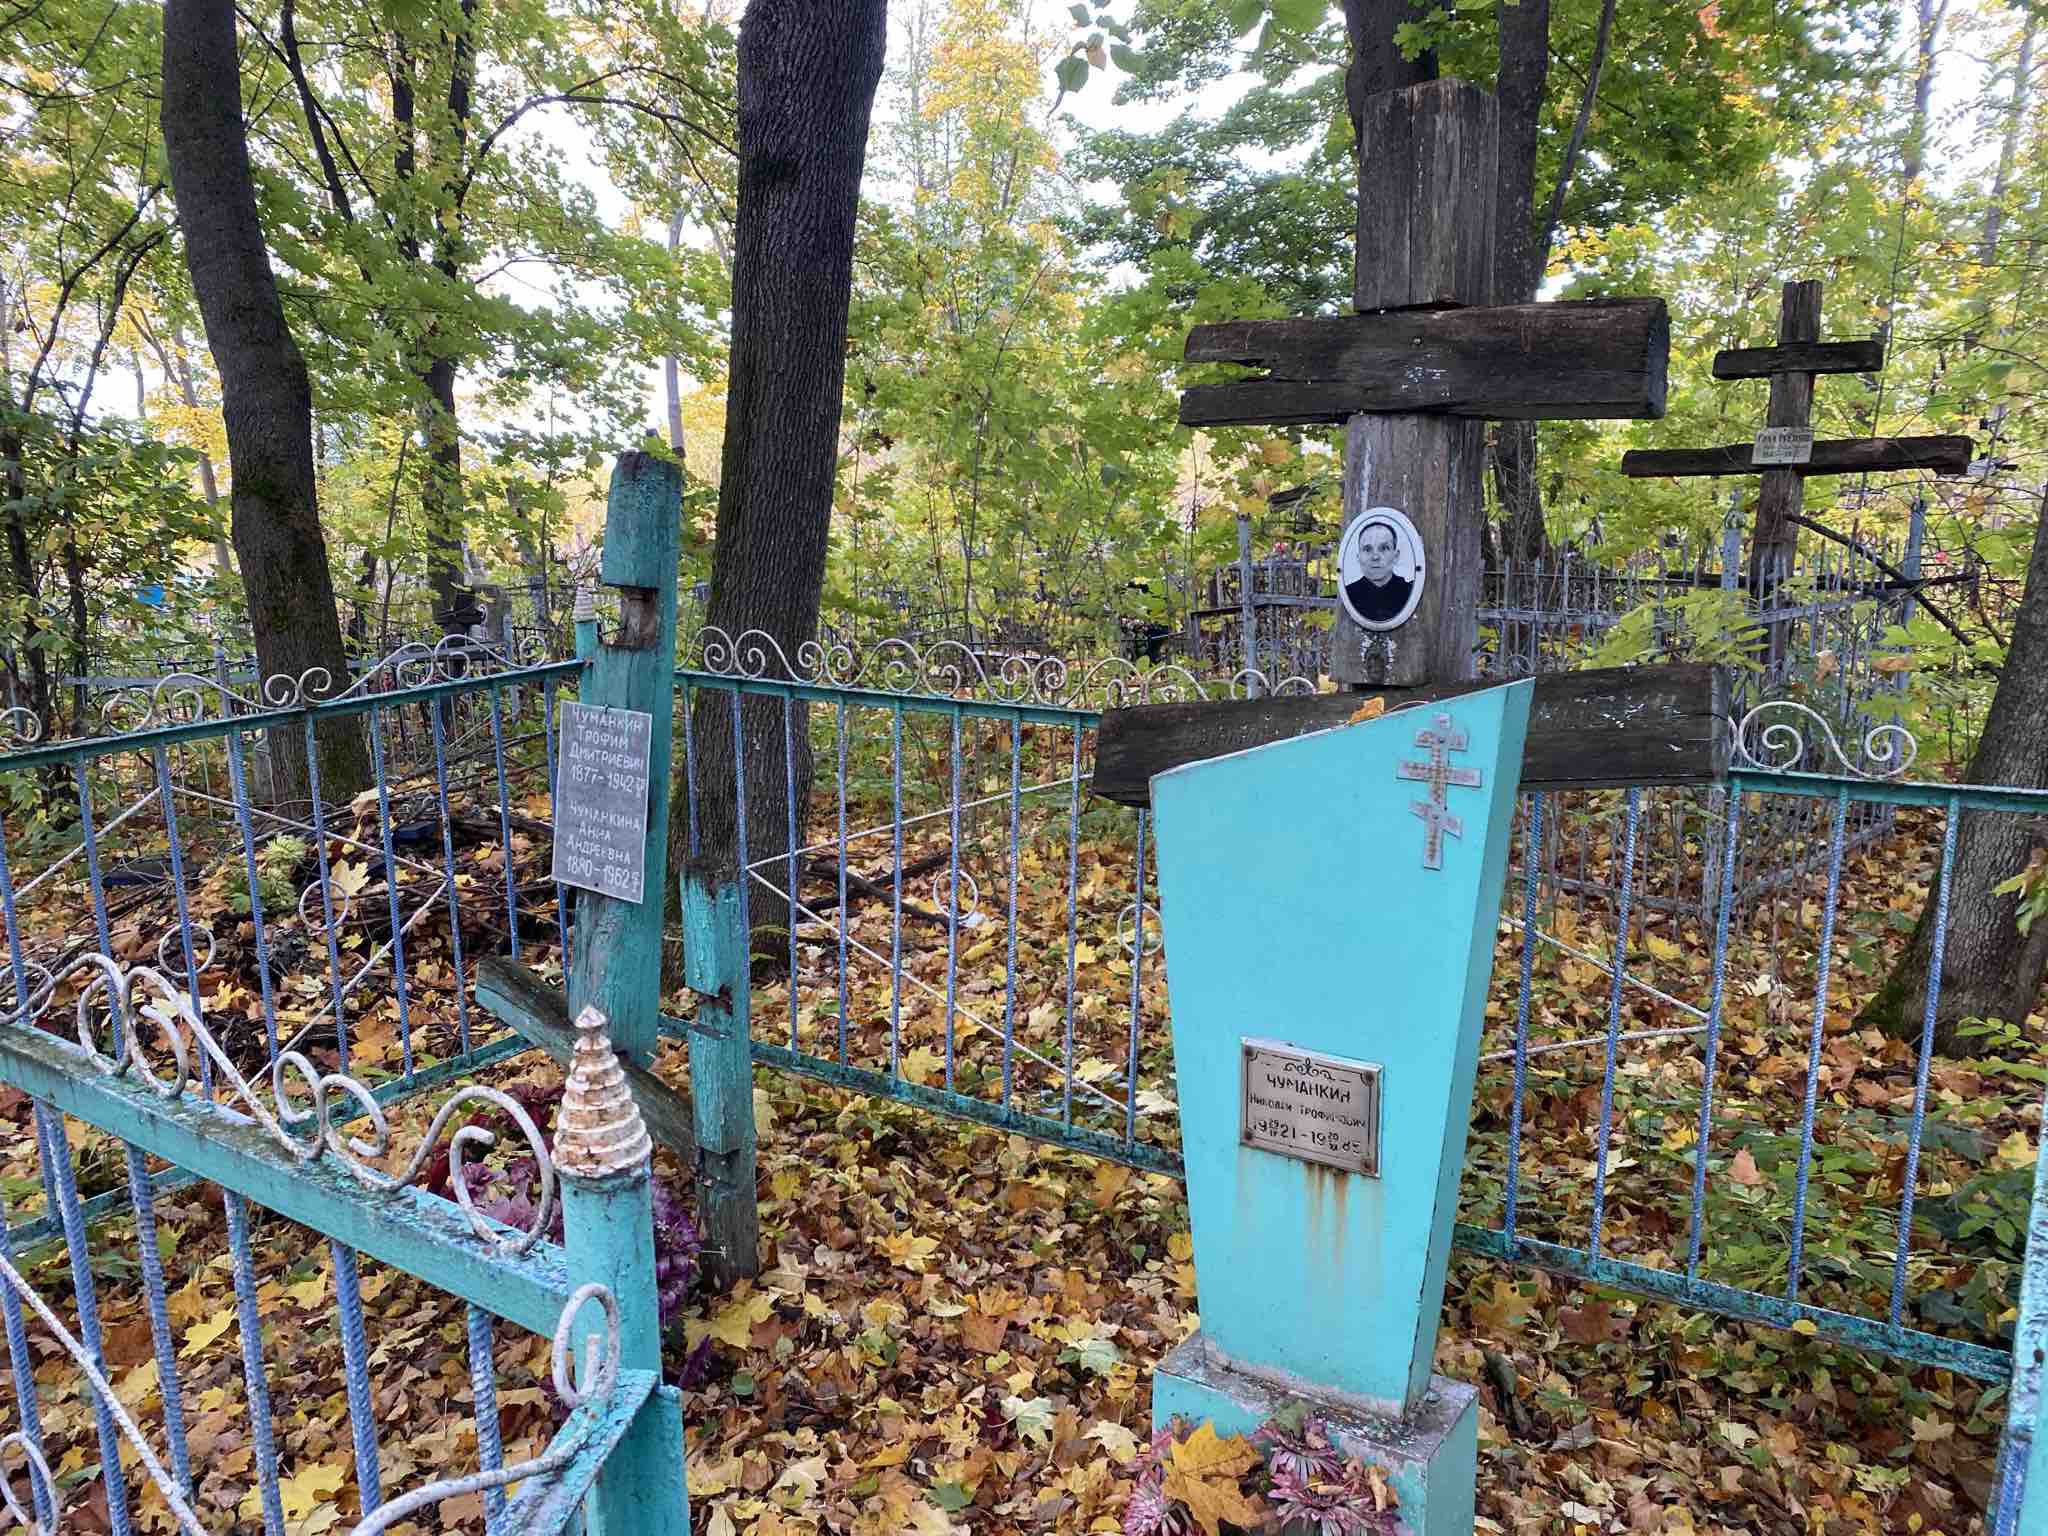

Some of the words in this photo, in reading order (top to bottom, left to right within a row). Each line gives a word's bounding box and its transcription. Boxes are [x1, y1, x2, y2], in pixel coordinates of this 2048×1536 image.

[573, 704, 642, 733] ЧУМАНКИН
[576, 724, 630, 750] ТРОФИМ
[578, 820, 612, 841] АННА
[566, 833, 631, 865] АНДРЕЕВНА
[1266, 1073, 1352, 1104] ЧУМАНКИН
